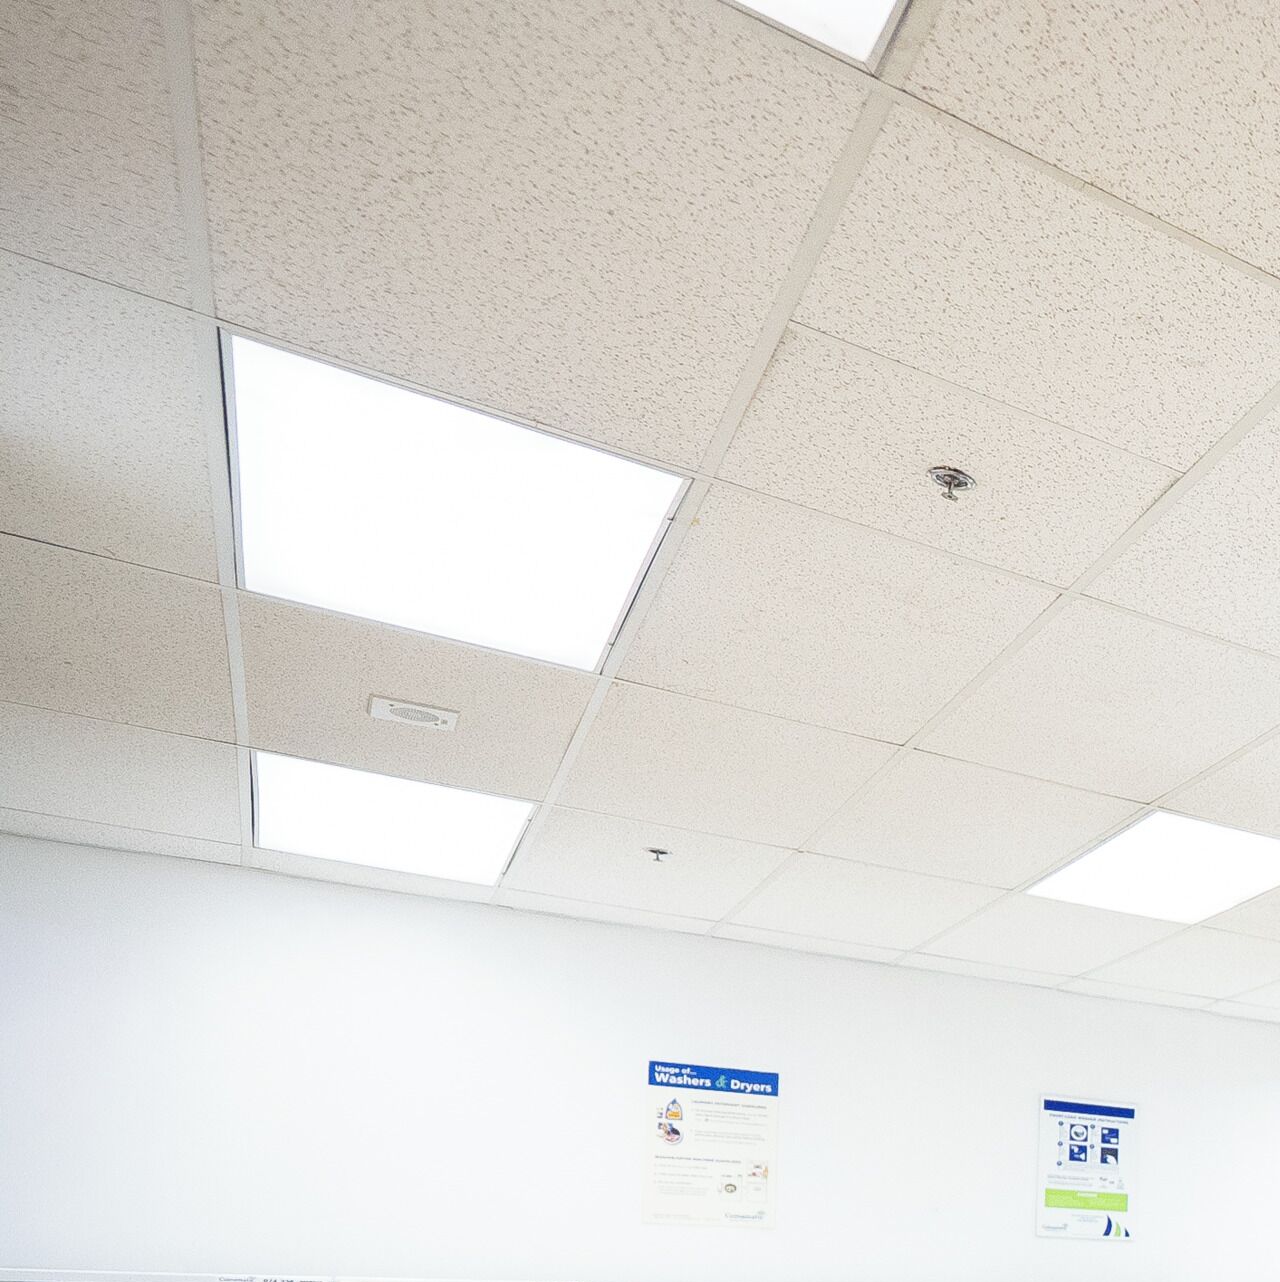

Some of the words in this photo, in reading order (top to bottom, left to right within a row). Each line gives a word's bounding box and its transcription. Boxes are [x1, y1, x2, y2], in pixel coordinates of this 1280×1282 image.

[655, 1065, 679, 1074] Usage
[655, 1073, 711, 1087] Washers
[715, 1075, 728, 1088] &
[731, 1080, 772, 1093] Dryers
